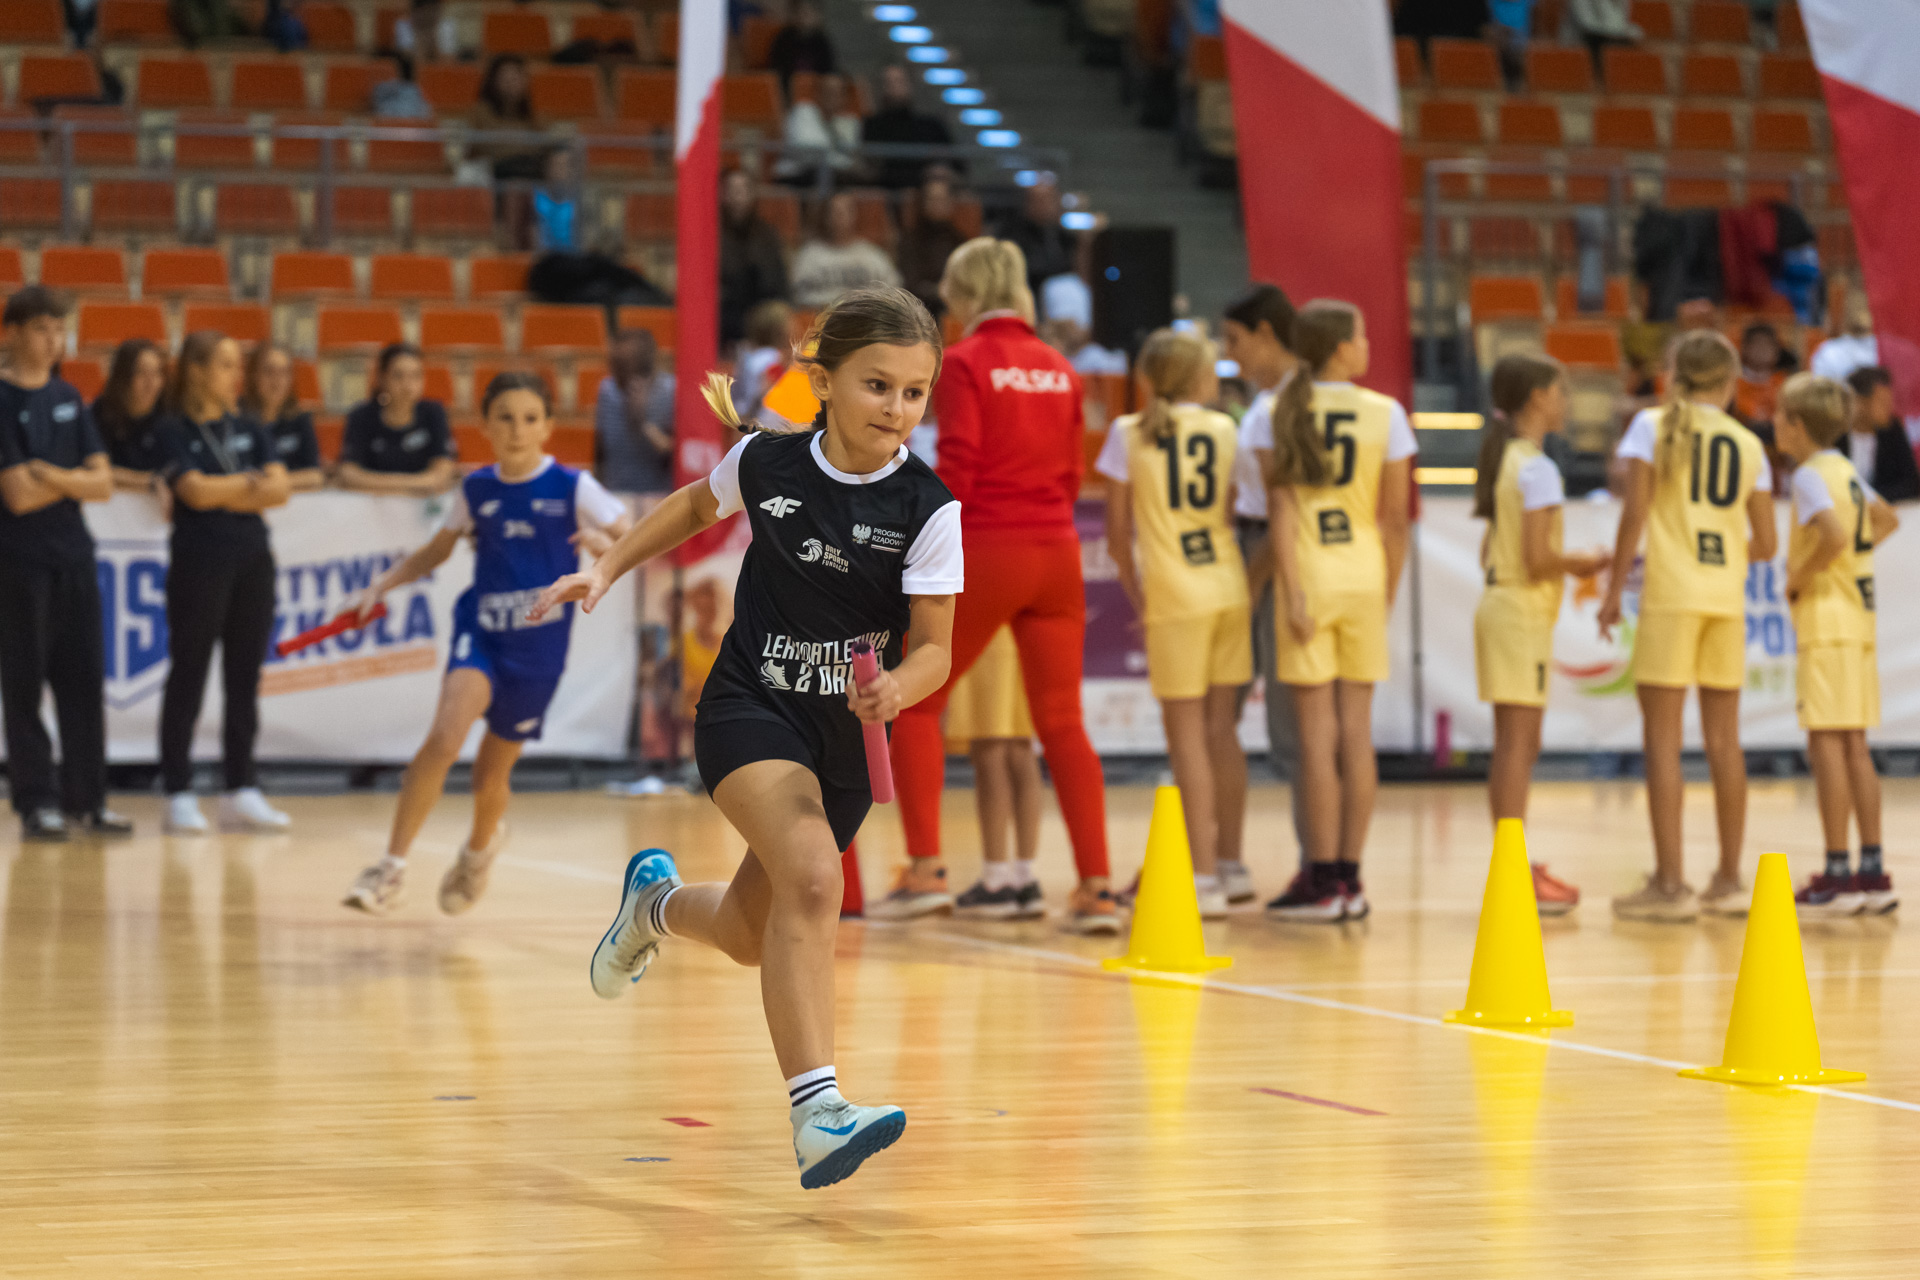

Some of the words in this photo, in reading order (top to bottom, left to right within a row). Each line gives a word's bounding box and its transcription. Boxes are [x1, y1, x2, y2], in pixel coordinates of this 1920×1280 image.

[990, 366, 1071, 394] POLSKA
[1157, 434, 1216, 511] 13
[1691, 432, 1741, 507] 10
[759, 495, 803, 519] 4F
[871, 535, 905, 547] RZĄDOWY
[873, 527, 906, 540] PROGRAM
[821, 560, 849, 574] FUNDACJA
[823, 552, 849, 567] SPORTU
